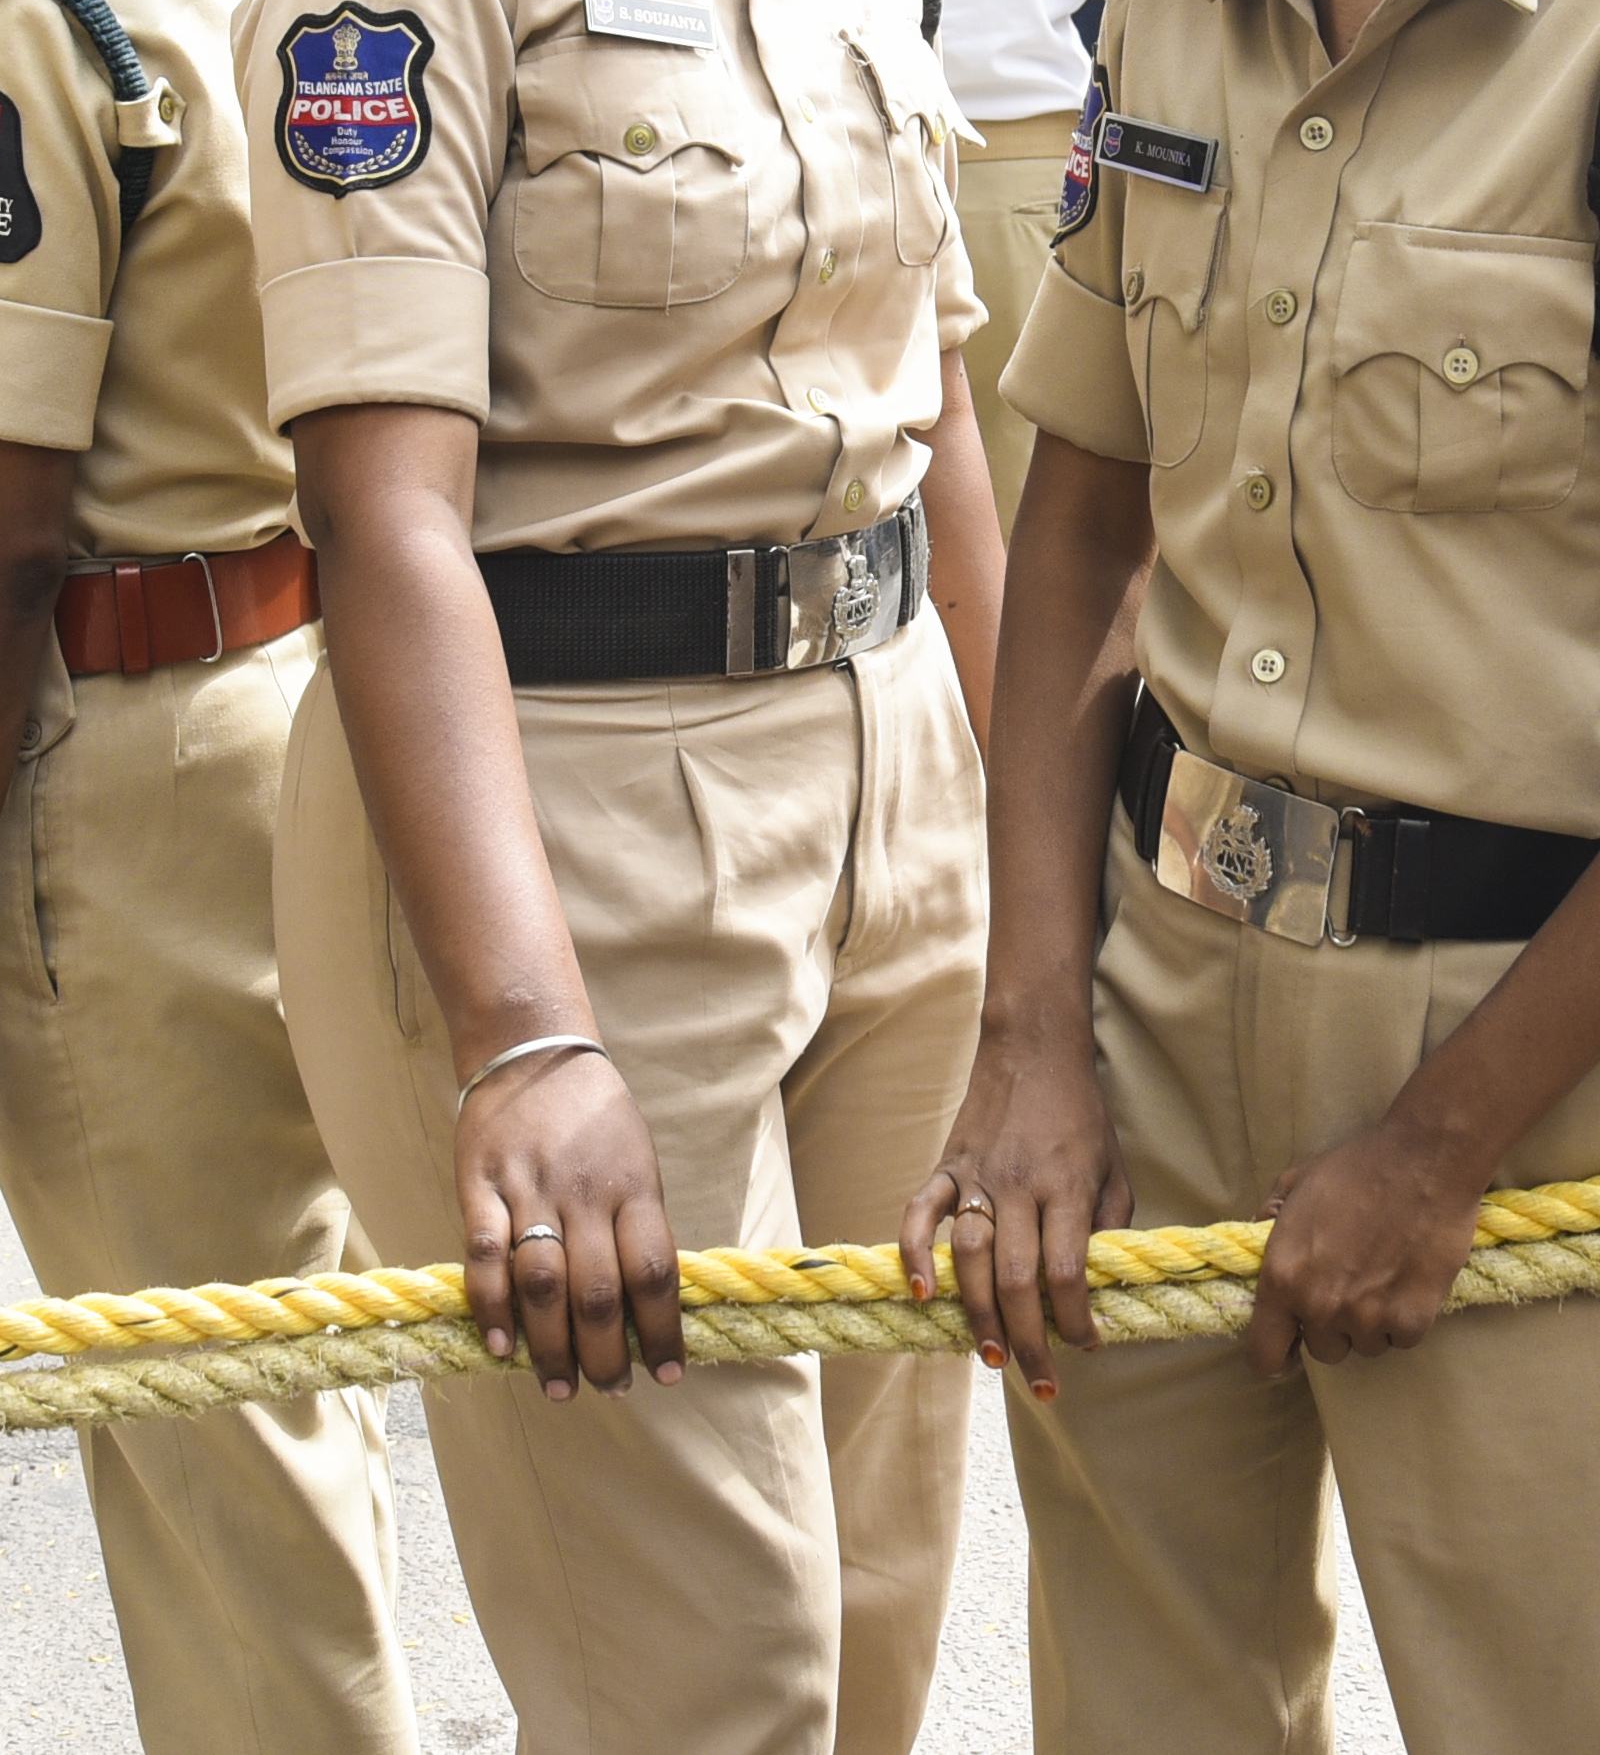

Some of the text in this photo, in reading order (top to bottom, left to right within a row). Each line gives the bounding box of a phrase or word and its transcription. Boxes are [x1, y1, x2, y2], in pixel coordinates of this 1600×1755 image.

[634, 8, 708, 33] SOUJANYA
[298, 77, 403, 96] TELANGANA STATE
[292, 97, 410, 121] POLICE
[331, 136, 364, 145] Honour
[337, 126, 358, 137] Duty
[322, 146, 374, 156] Compassion
[1147, 144, 1192, 167] MOUNIKA
